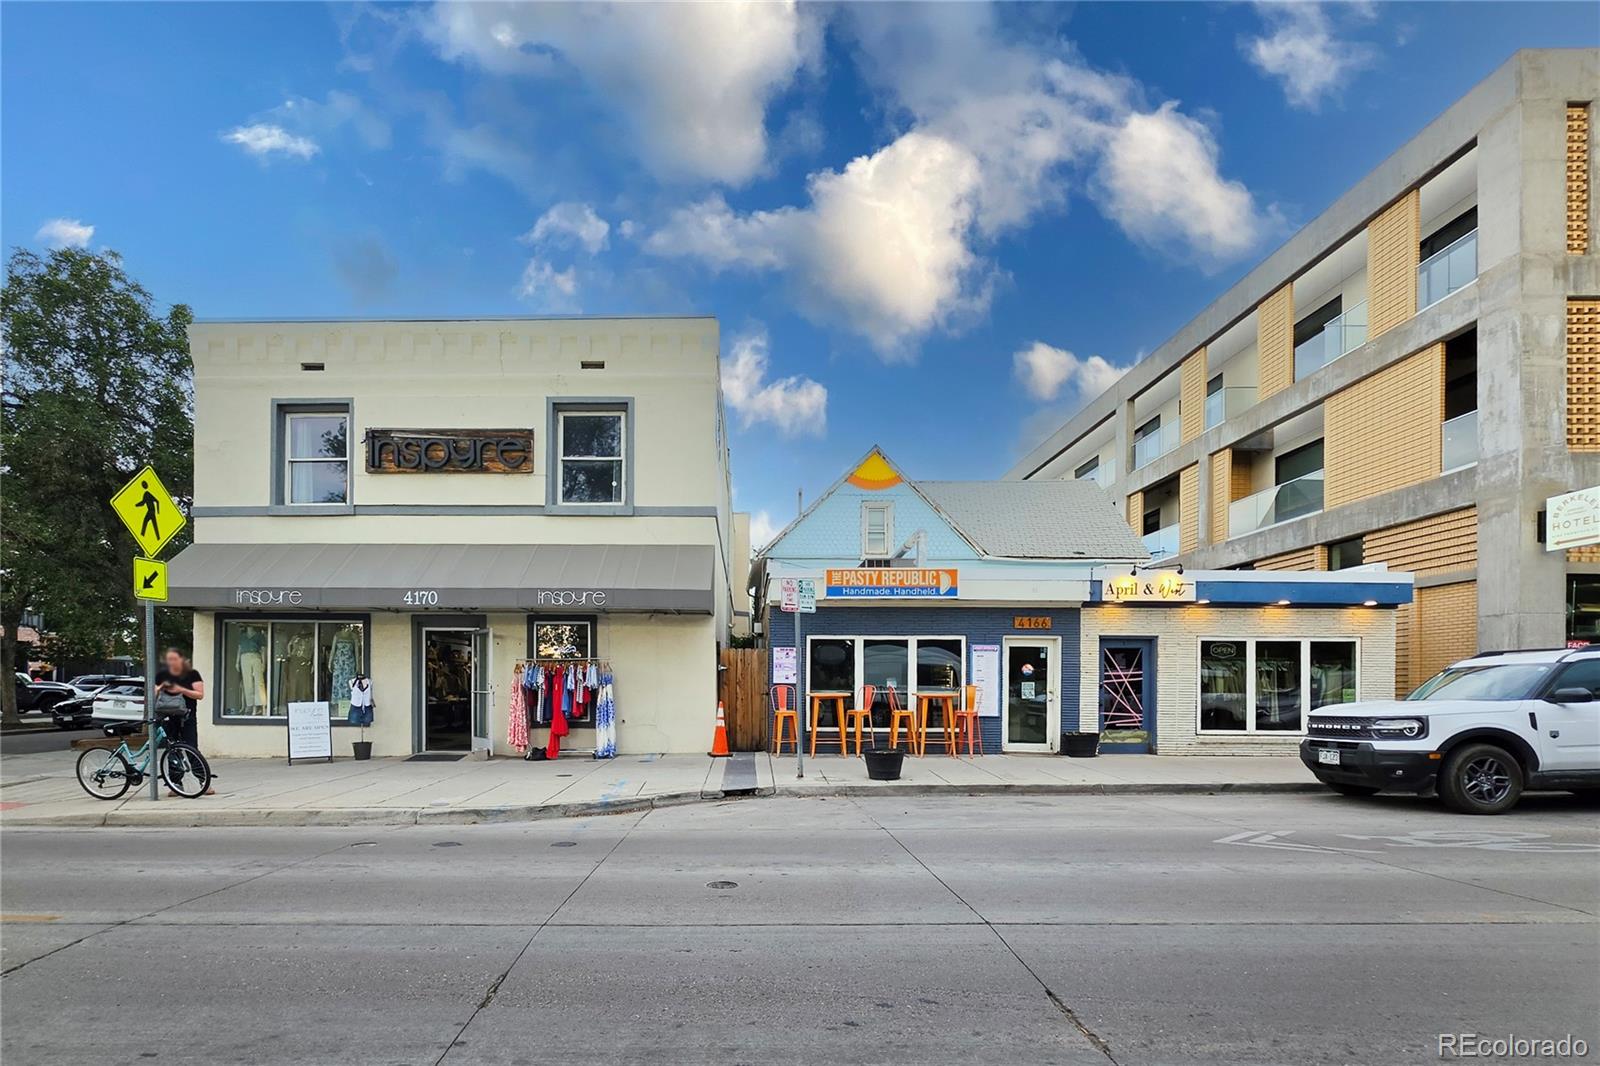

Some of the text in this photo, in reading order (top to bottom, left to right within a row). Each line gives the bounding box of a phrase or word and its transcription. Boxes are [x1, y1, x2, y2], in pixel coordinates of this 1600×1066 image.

[367, 433, 528, 470] inspyre
[1552, 514, 1600, 531] HOTEL
[832, 570, 842, 586] THE
[843, 570, 937, 586] PASTY REPUBLIC
[236, 589, 303, 605] inspyre
[403, 590, 438, 605] 4170
[537, 589, 606, 606] inspyre
[842, 587, 938, 596] Handmade. Handheld.
[1105, 582, 1138, 599] April
[1143, 582, 1154, 596] &
[1018, 617, 1048, 628] 4166
[1212, 646, 1234, 654] OPEN
